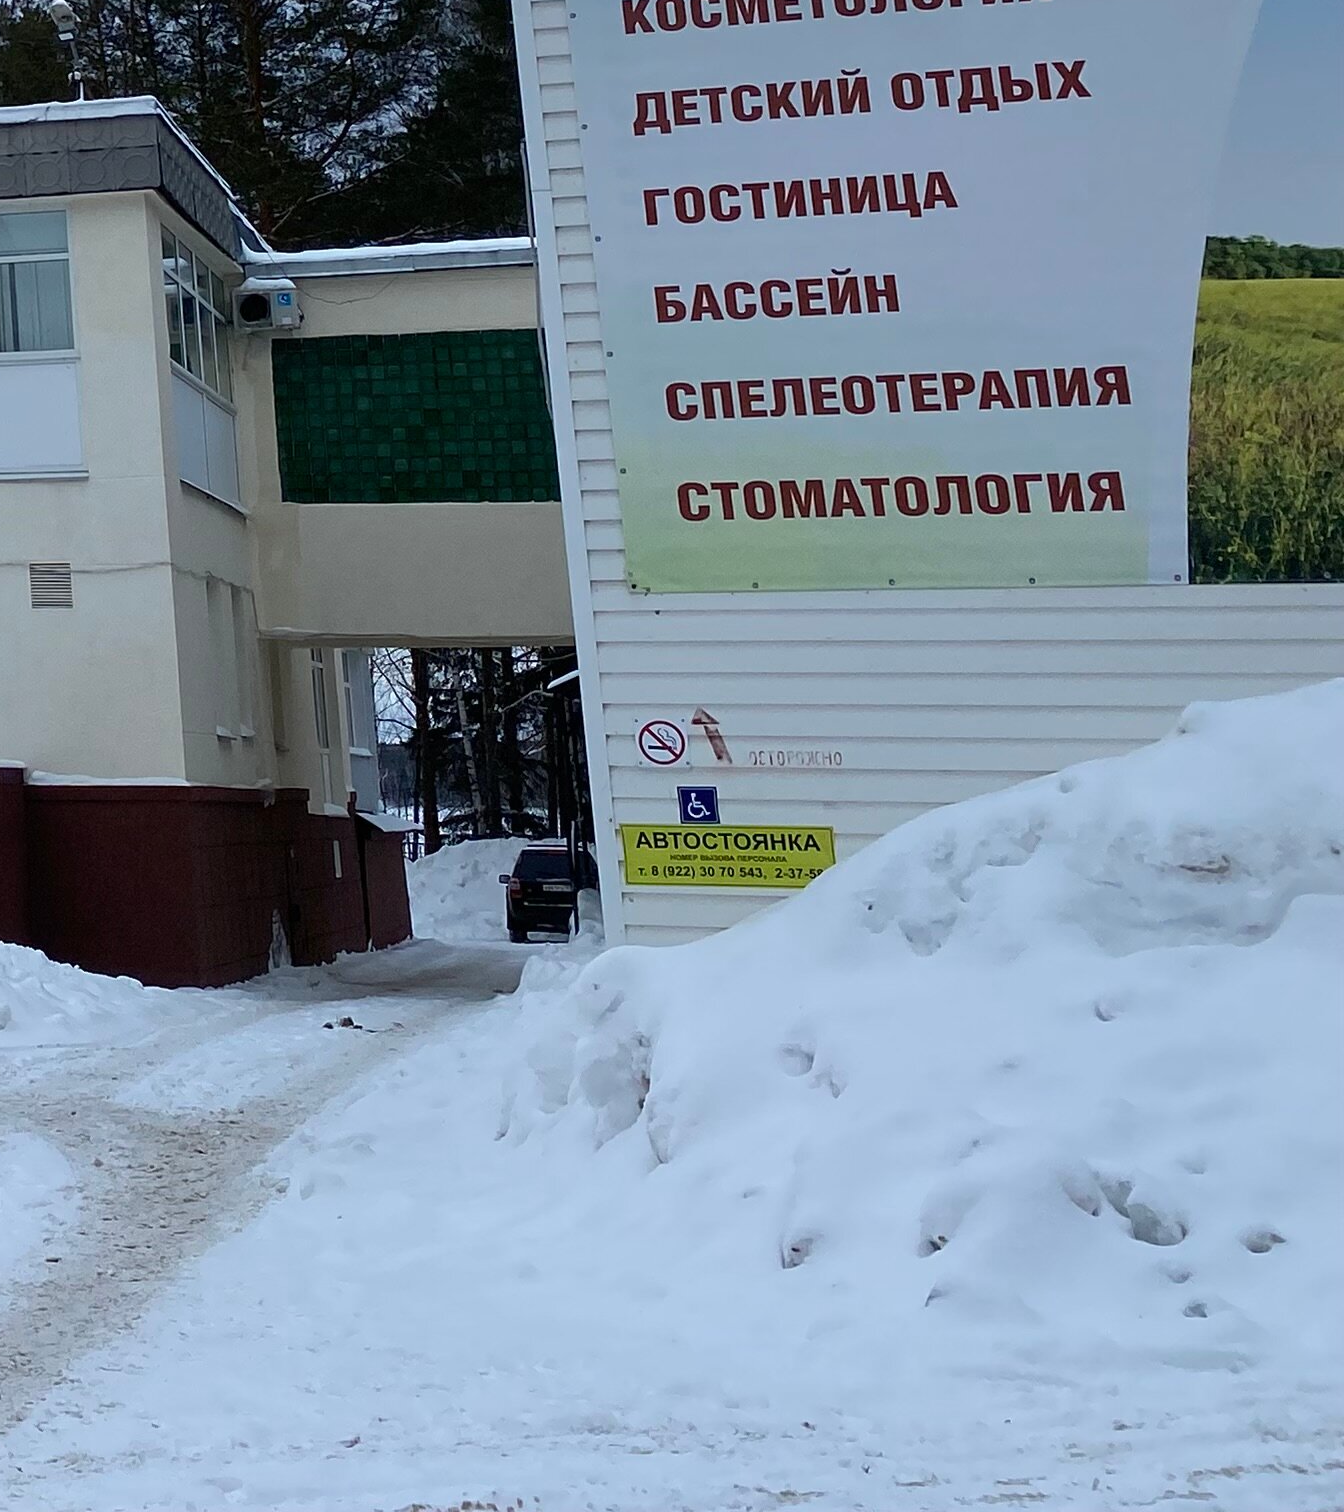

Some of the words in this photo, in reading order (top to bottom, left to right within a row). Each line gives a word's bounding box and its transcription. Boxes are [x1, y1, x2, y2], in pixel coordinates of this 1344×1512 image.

[632, 67, 872, 137] ДЕТСКИЙ
[889, 59, 1092, 114] ОТДЫХ
[642, 170, 959, 227] ГОСТИНИЦА
[653, 266, 901, 324] БАССЕЙН
[664, 364, 1132, 422] СПЕЛЕОТЕРАПИЯ
[676, 470, 1126, 523] СТОМАТОЛОГИЯ
[635, 831, 821, 852] АВТОСТОЯНКА
[700, 854, 735, 862] ВЫЗОВА
[737, 855, 788, 863] ПЕРСОНАЛА
[652, 866, 659, 876] 8
[663, 866, 696, 879] (922)
[700, 866, 715, 877] 30
[719, 867, 735, 878] 70
